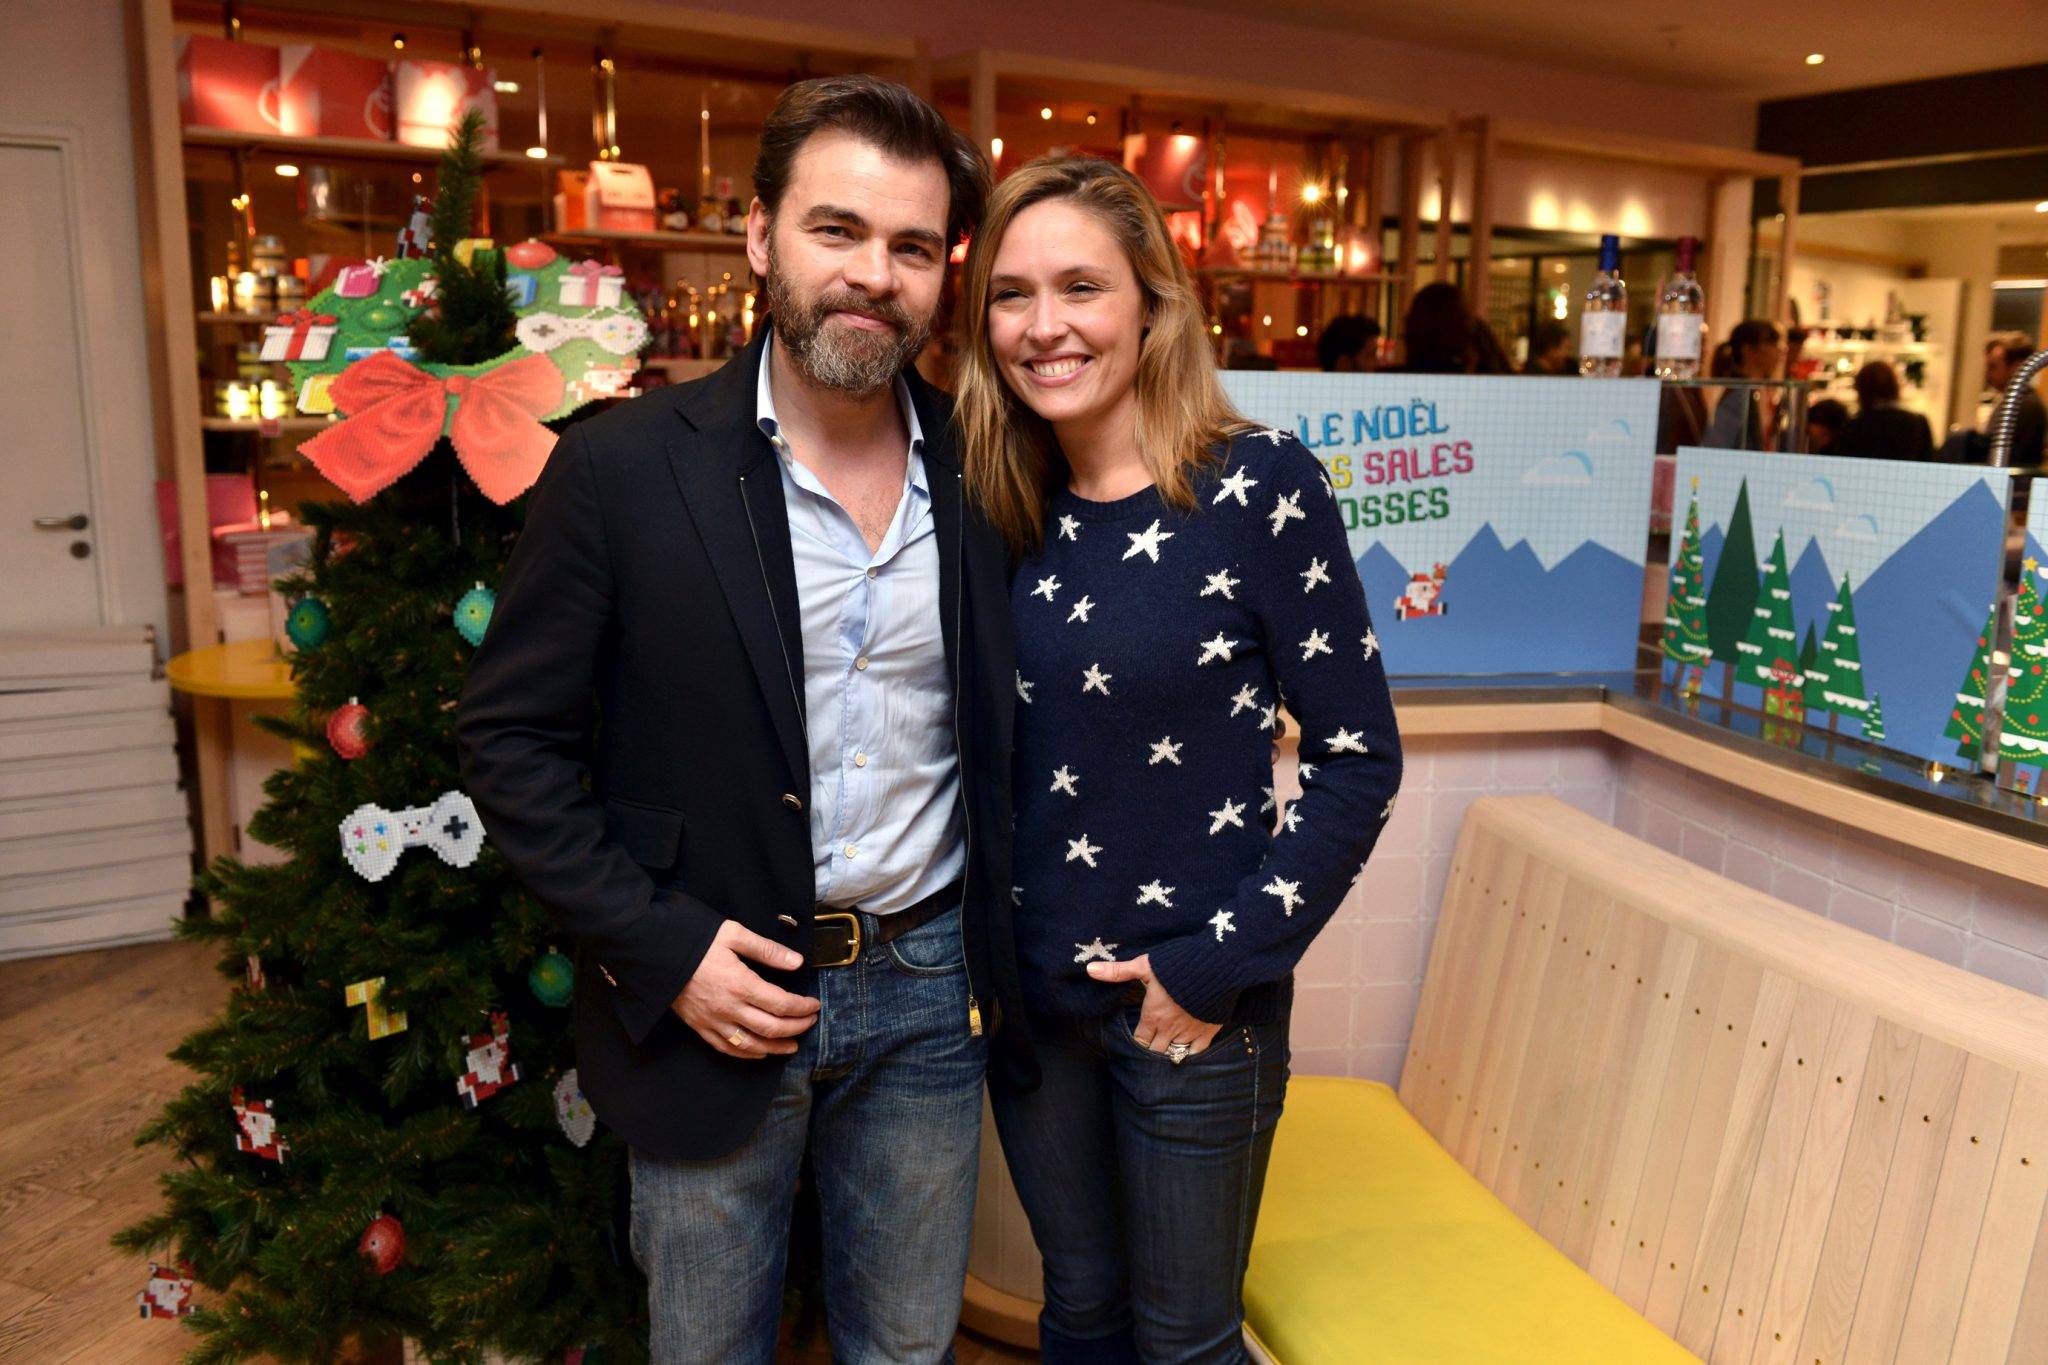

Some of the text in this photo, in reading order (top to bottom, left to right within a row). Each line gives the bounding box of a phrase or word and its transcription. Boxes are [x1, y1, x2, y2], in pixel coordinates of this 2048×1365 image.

[1298, 398, 1449, 449] LE NOËL
[1321, 440, 1474, 489] S SALES
[1337, 486, 1450, 531] OSSES
